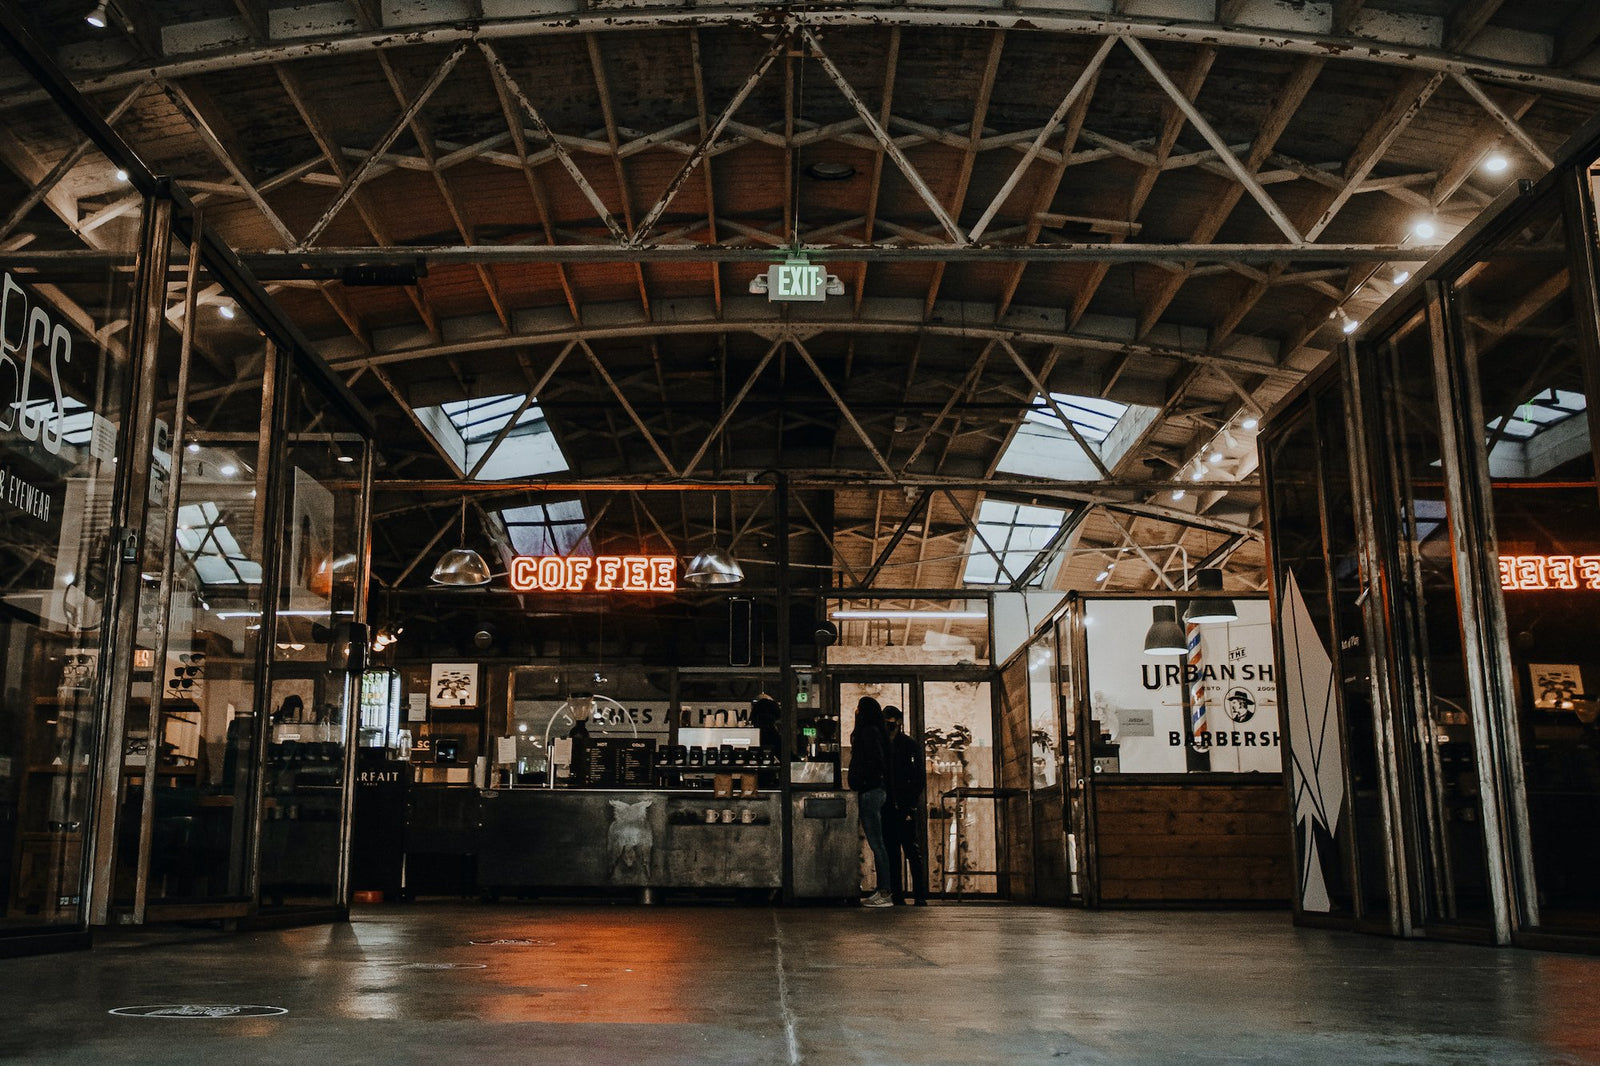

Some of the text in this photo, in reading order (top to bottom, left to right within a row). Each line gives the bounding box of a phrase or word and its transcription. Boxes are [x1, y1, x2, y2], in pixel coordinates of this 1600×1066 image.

[778, 266, 819, 296] EXIT
[9, 471, 51, 523] EYEWEAR
[510, 556, 676, 592] COFFEE
[1230, 648, 1246, 660] THE
[1141, 664, 1274, 691] URBAN SH
